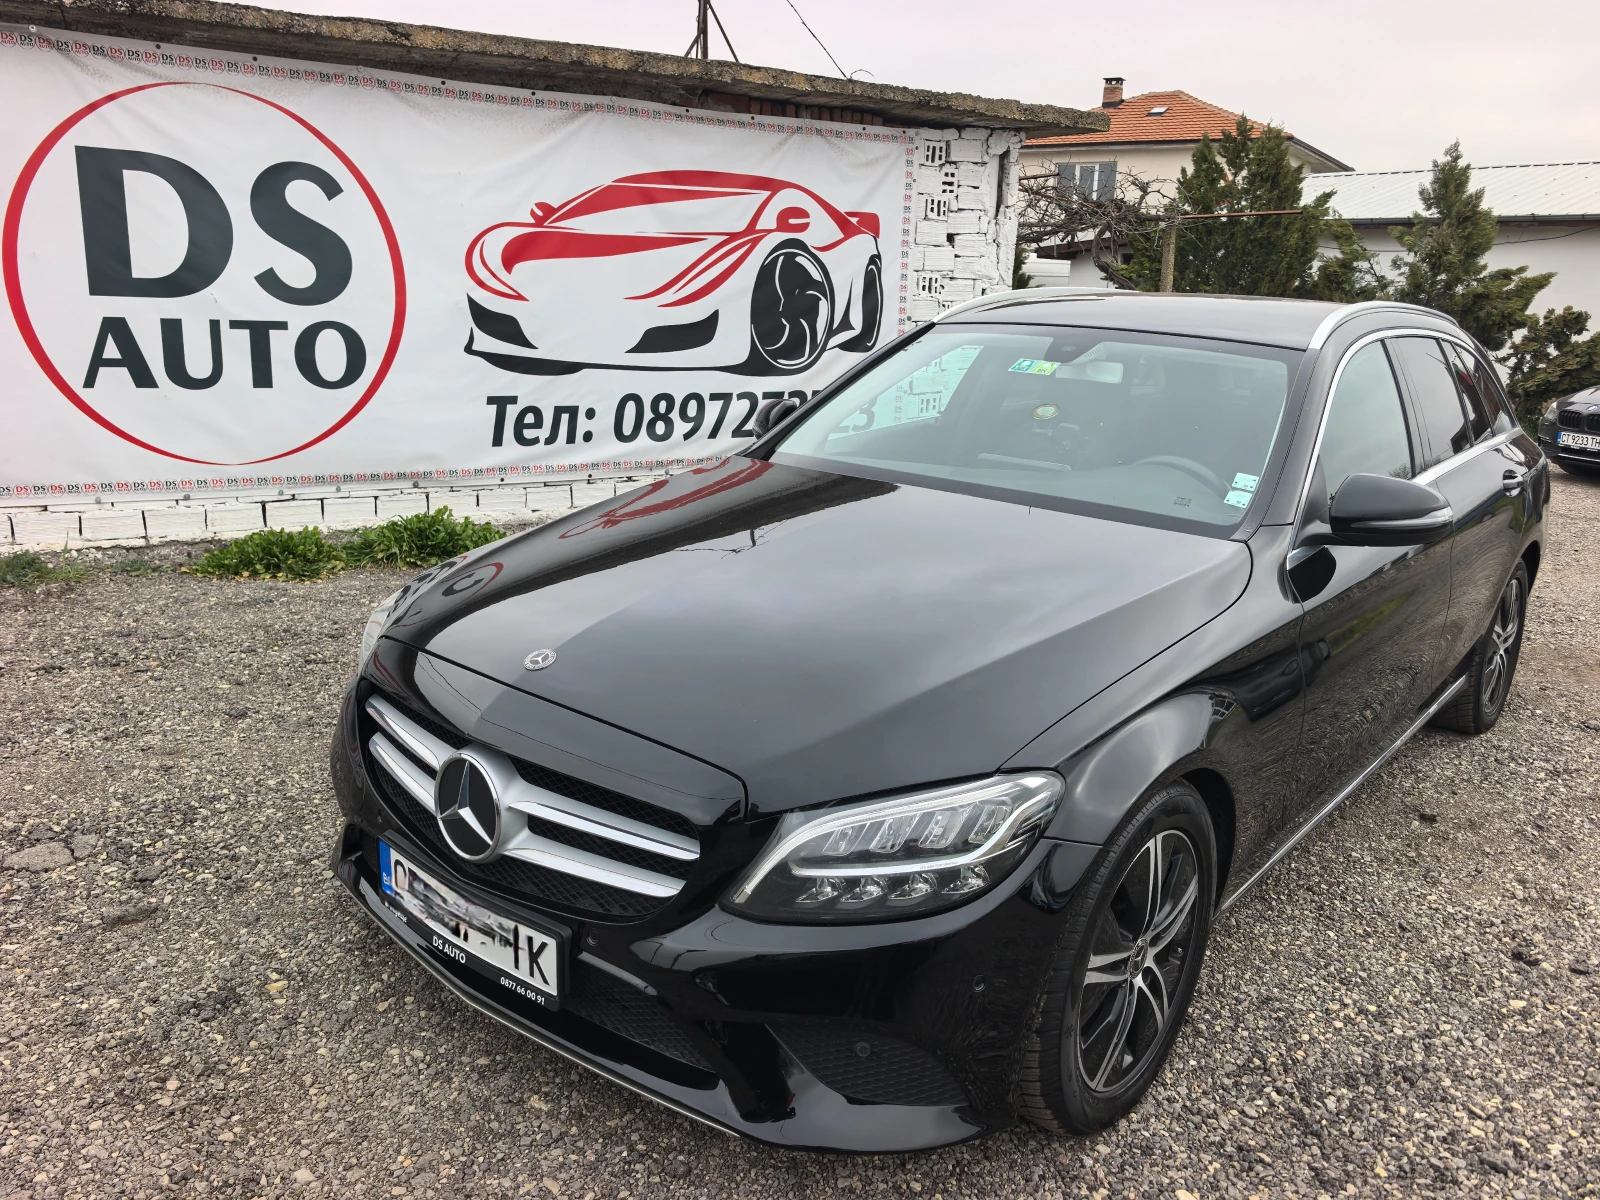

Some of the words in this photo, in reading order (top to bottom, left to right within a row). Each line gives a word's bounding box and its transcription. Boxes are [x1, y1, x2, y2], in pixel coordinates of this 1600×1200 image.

[1, 32, 14, 40] DS
[20, 34, 32, 42] DS
[38, 37, 51, 45] DS
[56, 40, 69, 49] DS
[75, 42, 87, 50] DS
[92, 45, 105, 53] DS
[75, 145, 352, 306] DS
[82, 317, 366, 390] AUTO
[486, 396, 595, 447] Тел:
[1562, 434, 1571, 443] CT
[1571, 435, 1588, 446] 9233
[432, 936, 443, 949] DS
[444, 944, 466, 964] AUTO
[500, 977, 516, 990] 0877
[517, 986, 525, 995] 66
[527, 990, 536, 1000] 00
[537, 996, 544, 1005] 91
